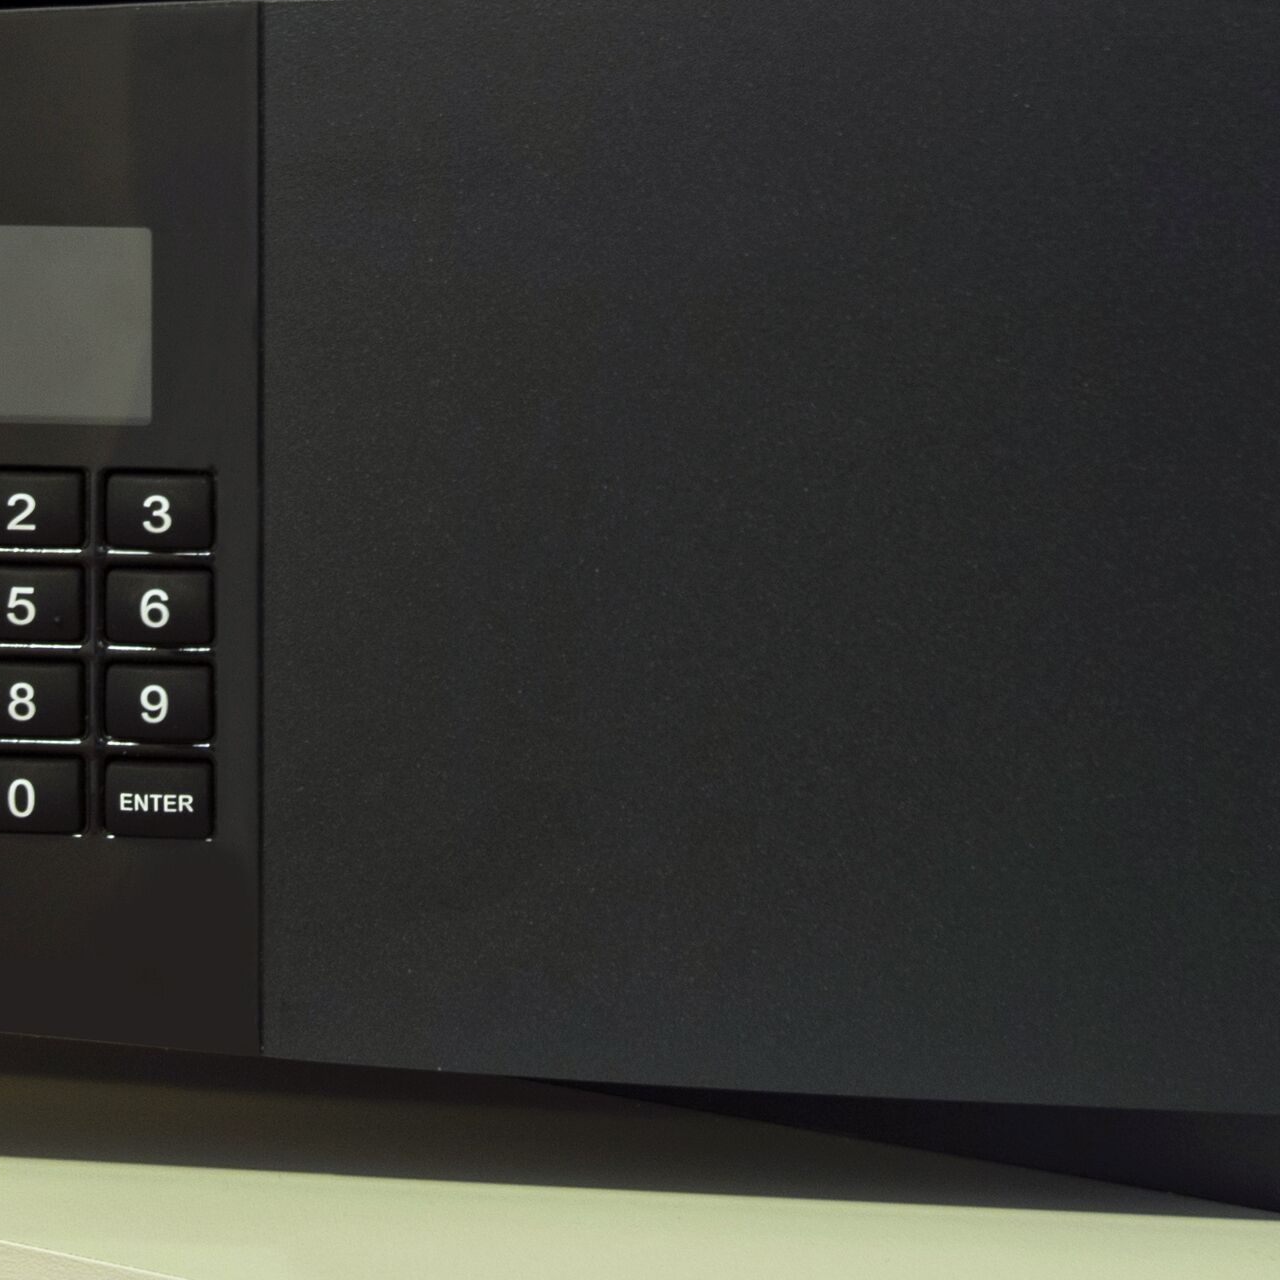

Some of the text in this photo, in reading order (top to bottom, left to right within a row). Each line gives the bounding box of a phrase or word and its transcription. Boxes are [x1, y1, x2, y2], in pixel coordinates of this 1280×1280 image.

[6, 492, 36, 531] 2
[142, 494, 172, 534] 3
[6, 586, 36, 626] 5
[139, 588, 170, 629] 6
[7, 681, 36, 722] 8
[139, 684, 169, 724] 9
[7, 778, 36, 818] 0
[119, 792, 194, 813] ENTER
